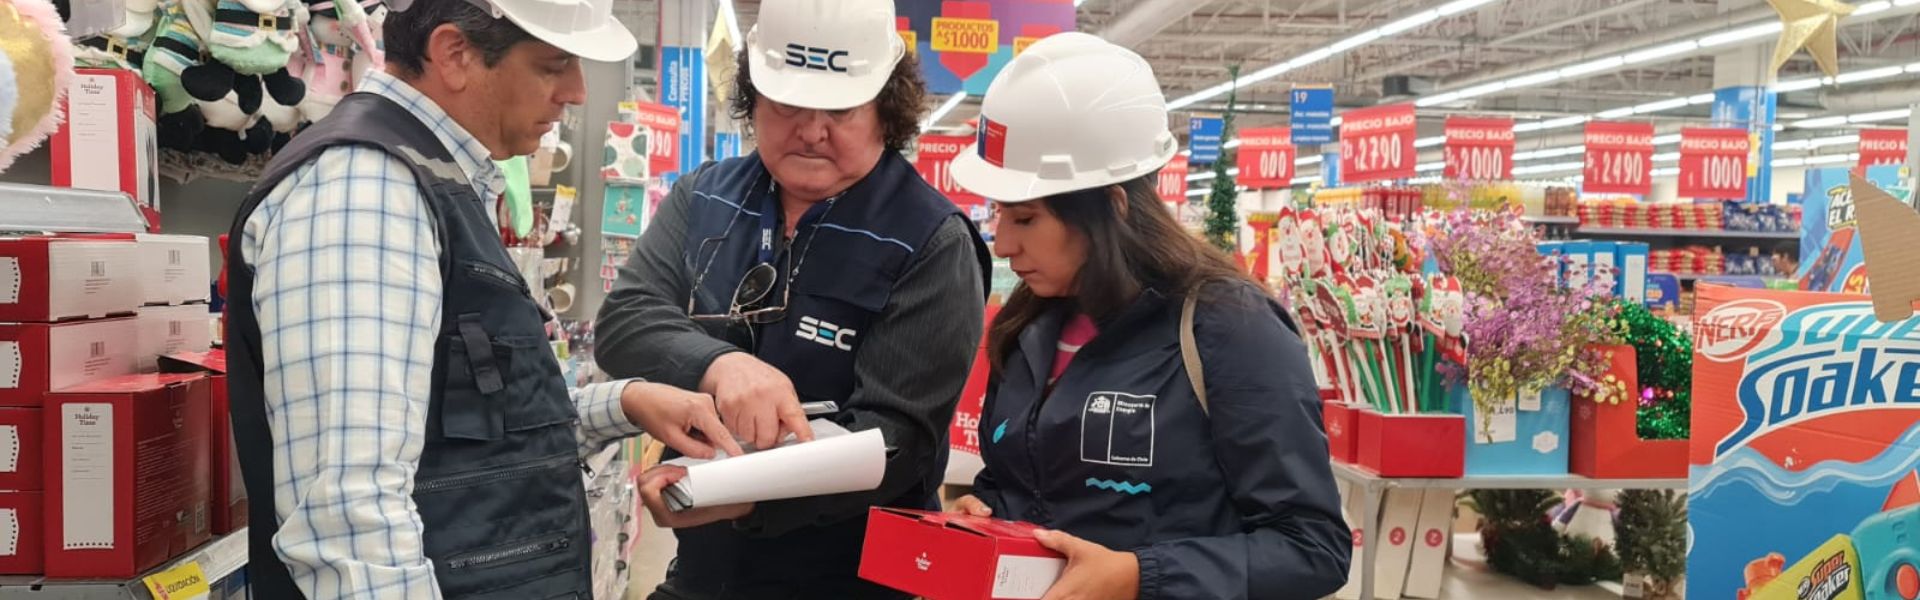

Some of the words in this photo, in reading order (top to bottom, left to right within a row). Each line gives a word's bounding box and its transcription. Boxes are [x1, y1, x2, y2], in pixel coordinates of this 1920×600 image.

[936, 21, 994, 33] PRODUCTOS
[785, 43, 848, 72] SEC
[1294, 91, 1308, 104] 19
[1343, 118, 1383, 133] PRECIO
[1385, 113, 1415, 128] BAJO
[1446, 129, 1484, 140] PRECIO
[1486, 129, 1514, 141] BAJO
[1587, 134, 1624, 145] PRECIO
[1626, 135, 1652, 146] BAJO
[919, 143, 958, 153] PRECIO
[1681, 139, 1720, 150] PRECIO
[1721, 139, 1749, 150] BAJO
[1860, 139, 1898, 150] PRECIO
[1602, 150, 1643, 185] 2490
[1702, 154, 1742, 190] 1000
[795, 315, 857, 351] SEC
[1694, 307, 1782, 352] NERF
